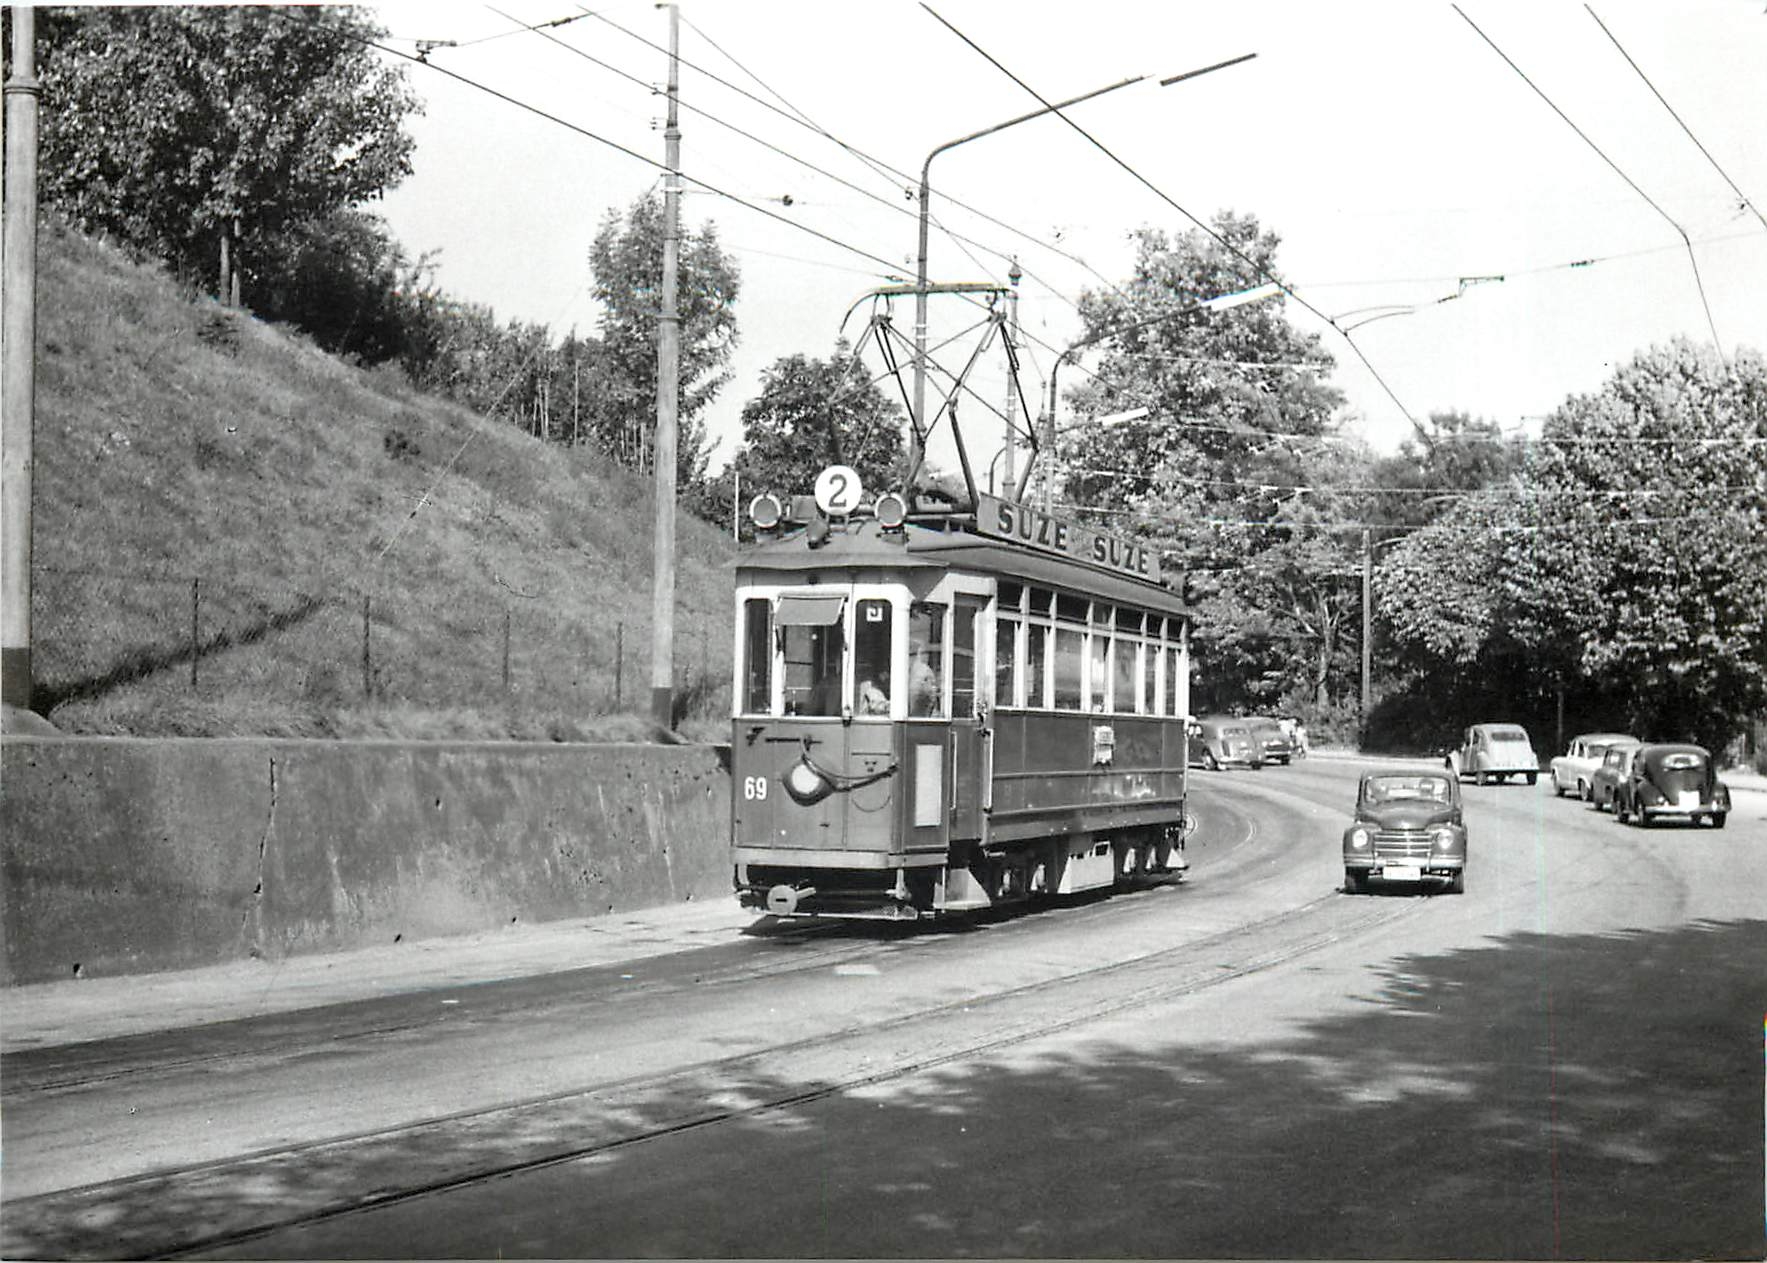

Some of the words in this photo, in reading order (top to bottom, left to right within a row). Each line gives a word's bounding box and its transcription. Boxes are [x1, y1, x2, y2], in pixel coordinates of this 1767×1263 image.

[829, 473, 847, 507] 2
[998, 503, 1067, 550] SUZE
[1093, 536, 1149, 574] SUZE
[744, 776, 767, 800] 69
